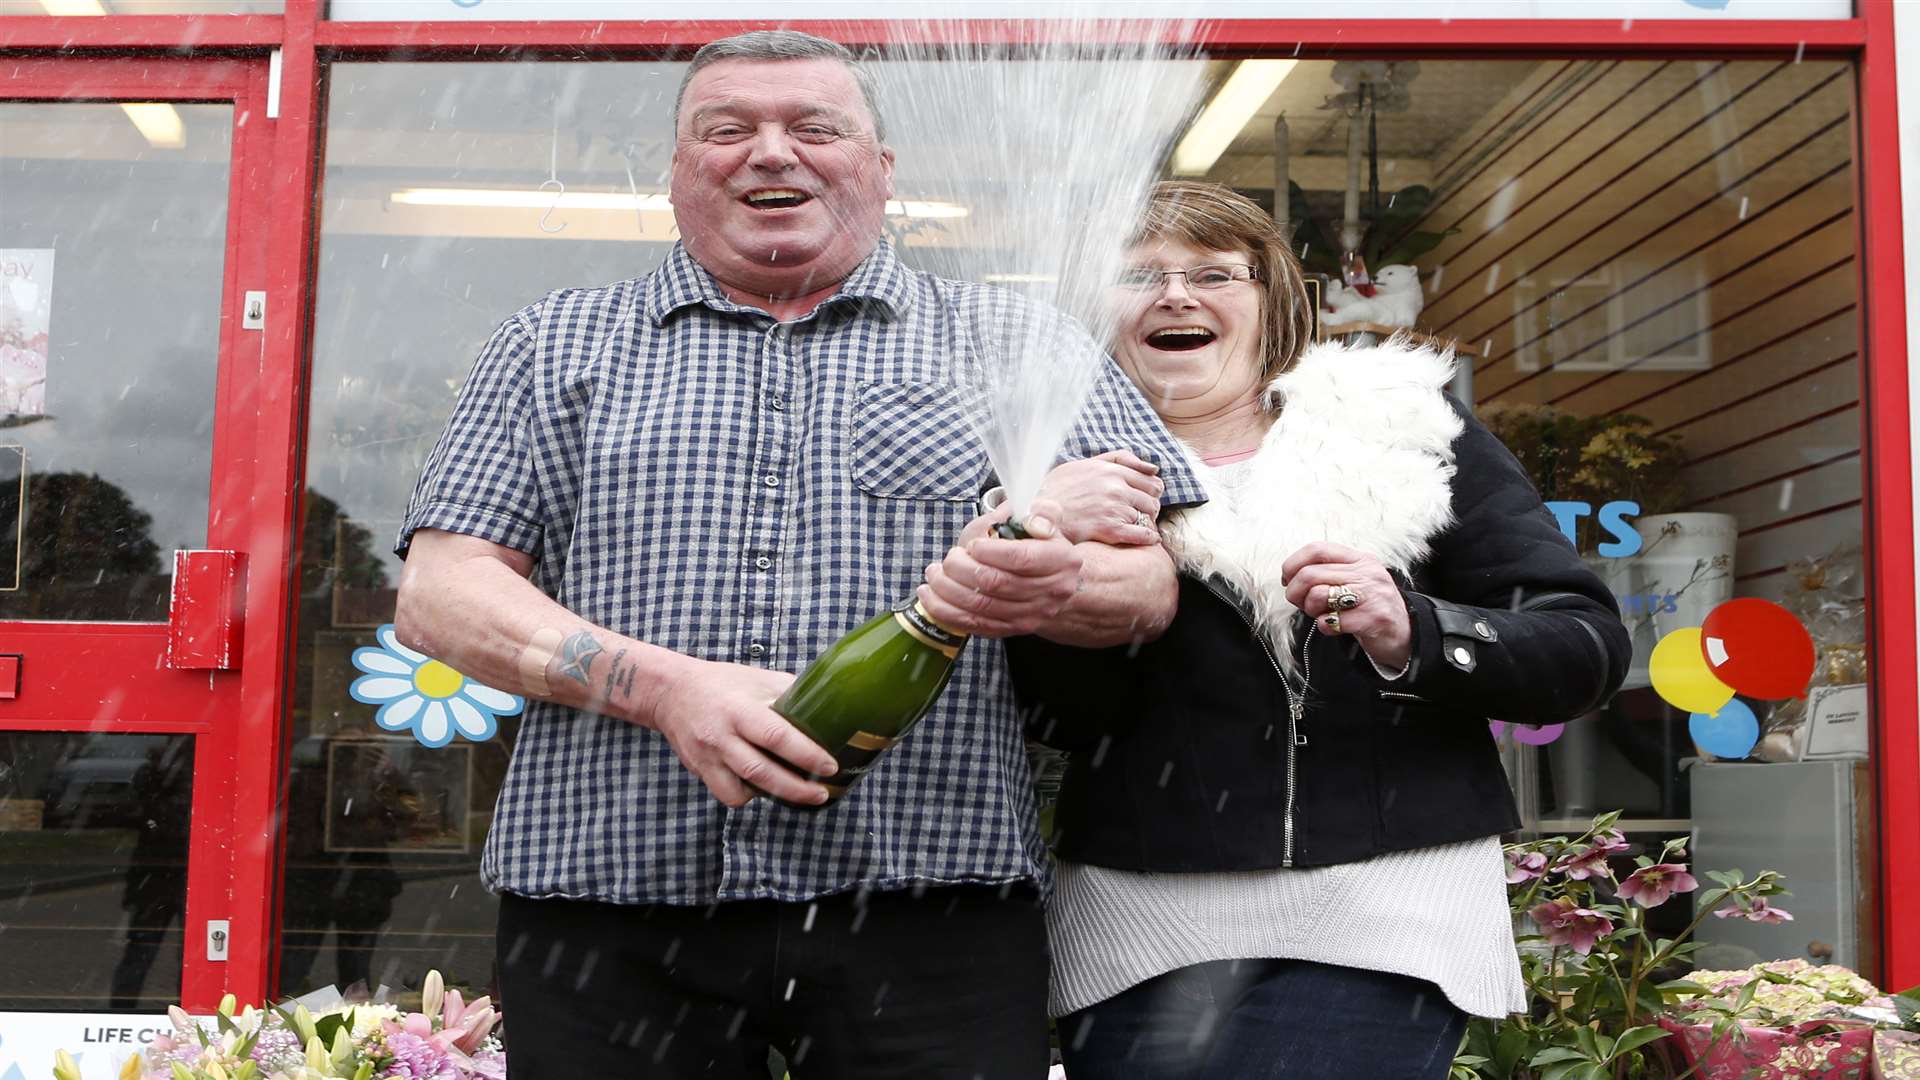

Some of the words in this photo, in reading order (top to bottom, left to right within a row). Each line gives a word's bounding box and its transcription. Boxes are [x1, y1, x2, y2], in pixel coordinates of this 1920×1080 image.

[0, 261, 34, 280] ay
[1544, 501, 1642, 558] TS
[84, 1027, 133, 1043] LIFE
